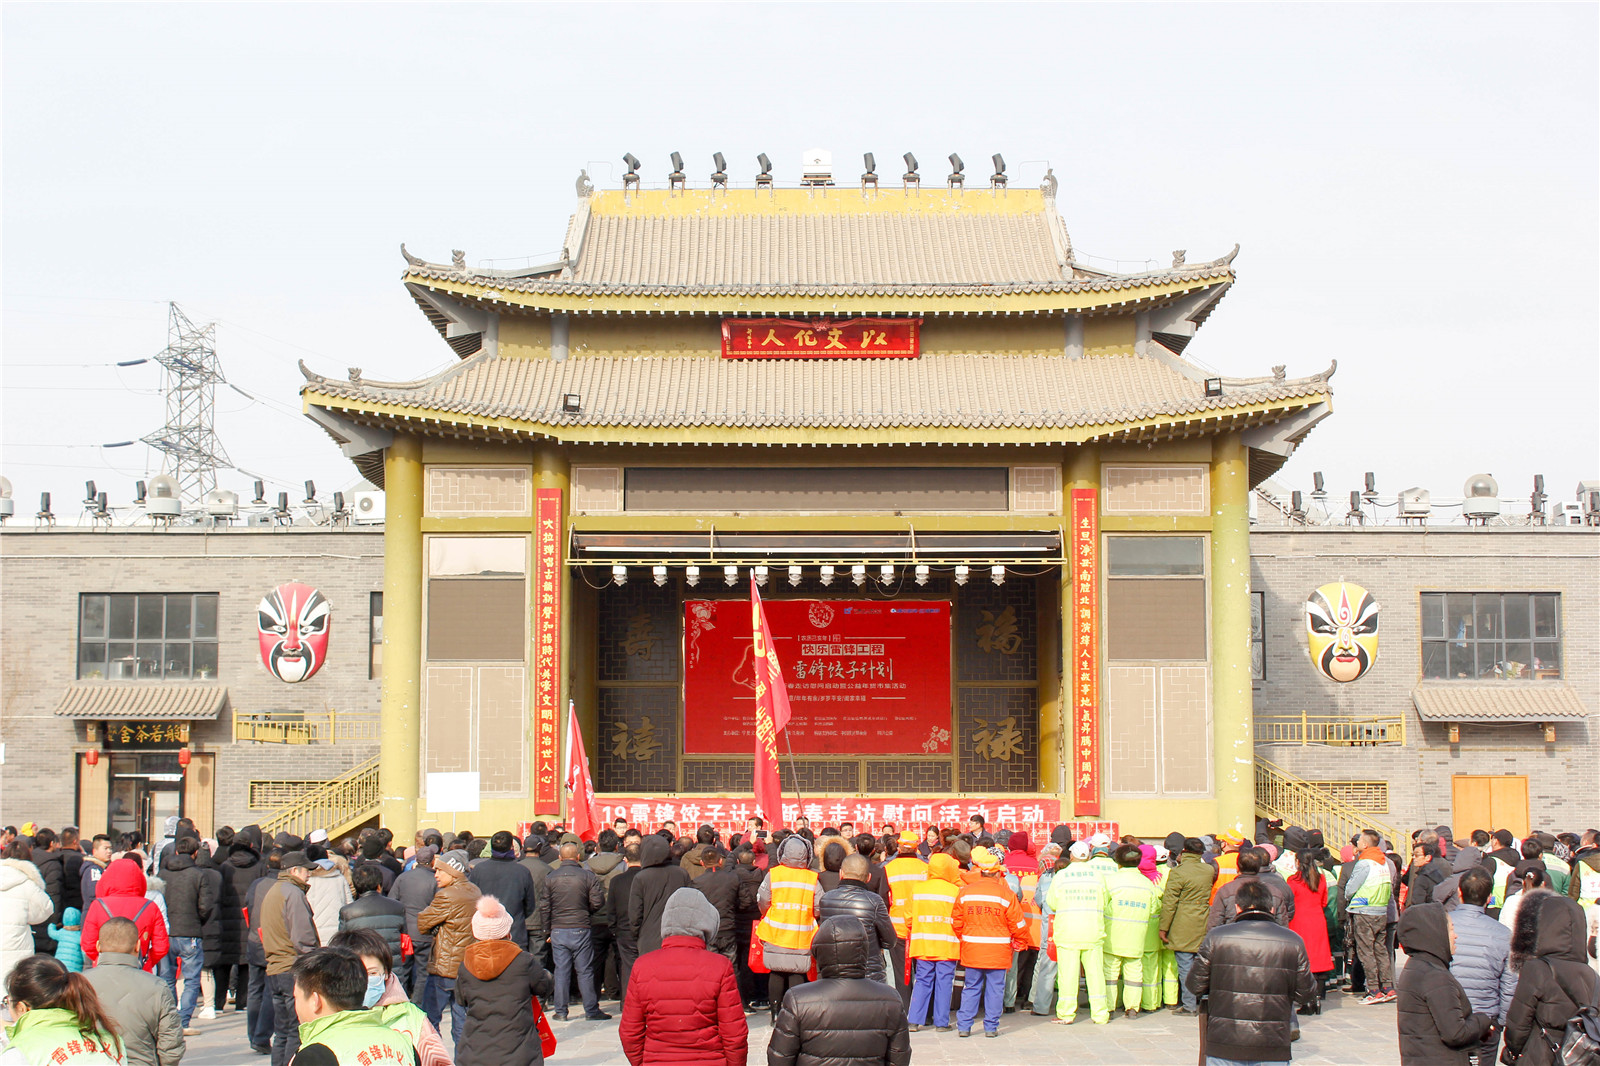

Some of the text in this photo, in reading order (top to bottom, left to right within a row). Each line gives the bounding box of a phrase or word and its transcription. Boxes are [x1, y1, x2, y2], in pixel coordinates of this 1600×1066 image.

[802, 644, 885, 656] 快乐雷锋工程
[793, 658, 894, 681] 雷锋饺子计划
[612, 716, 662, 762] 禧
[967, 905, 1002, 917] 西夏环卫
